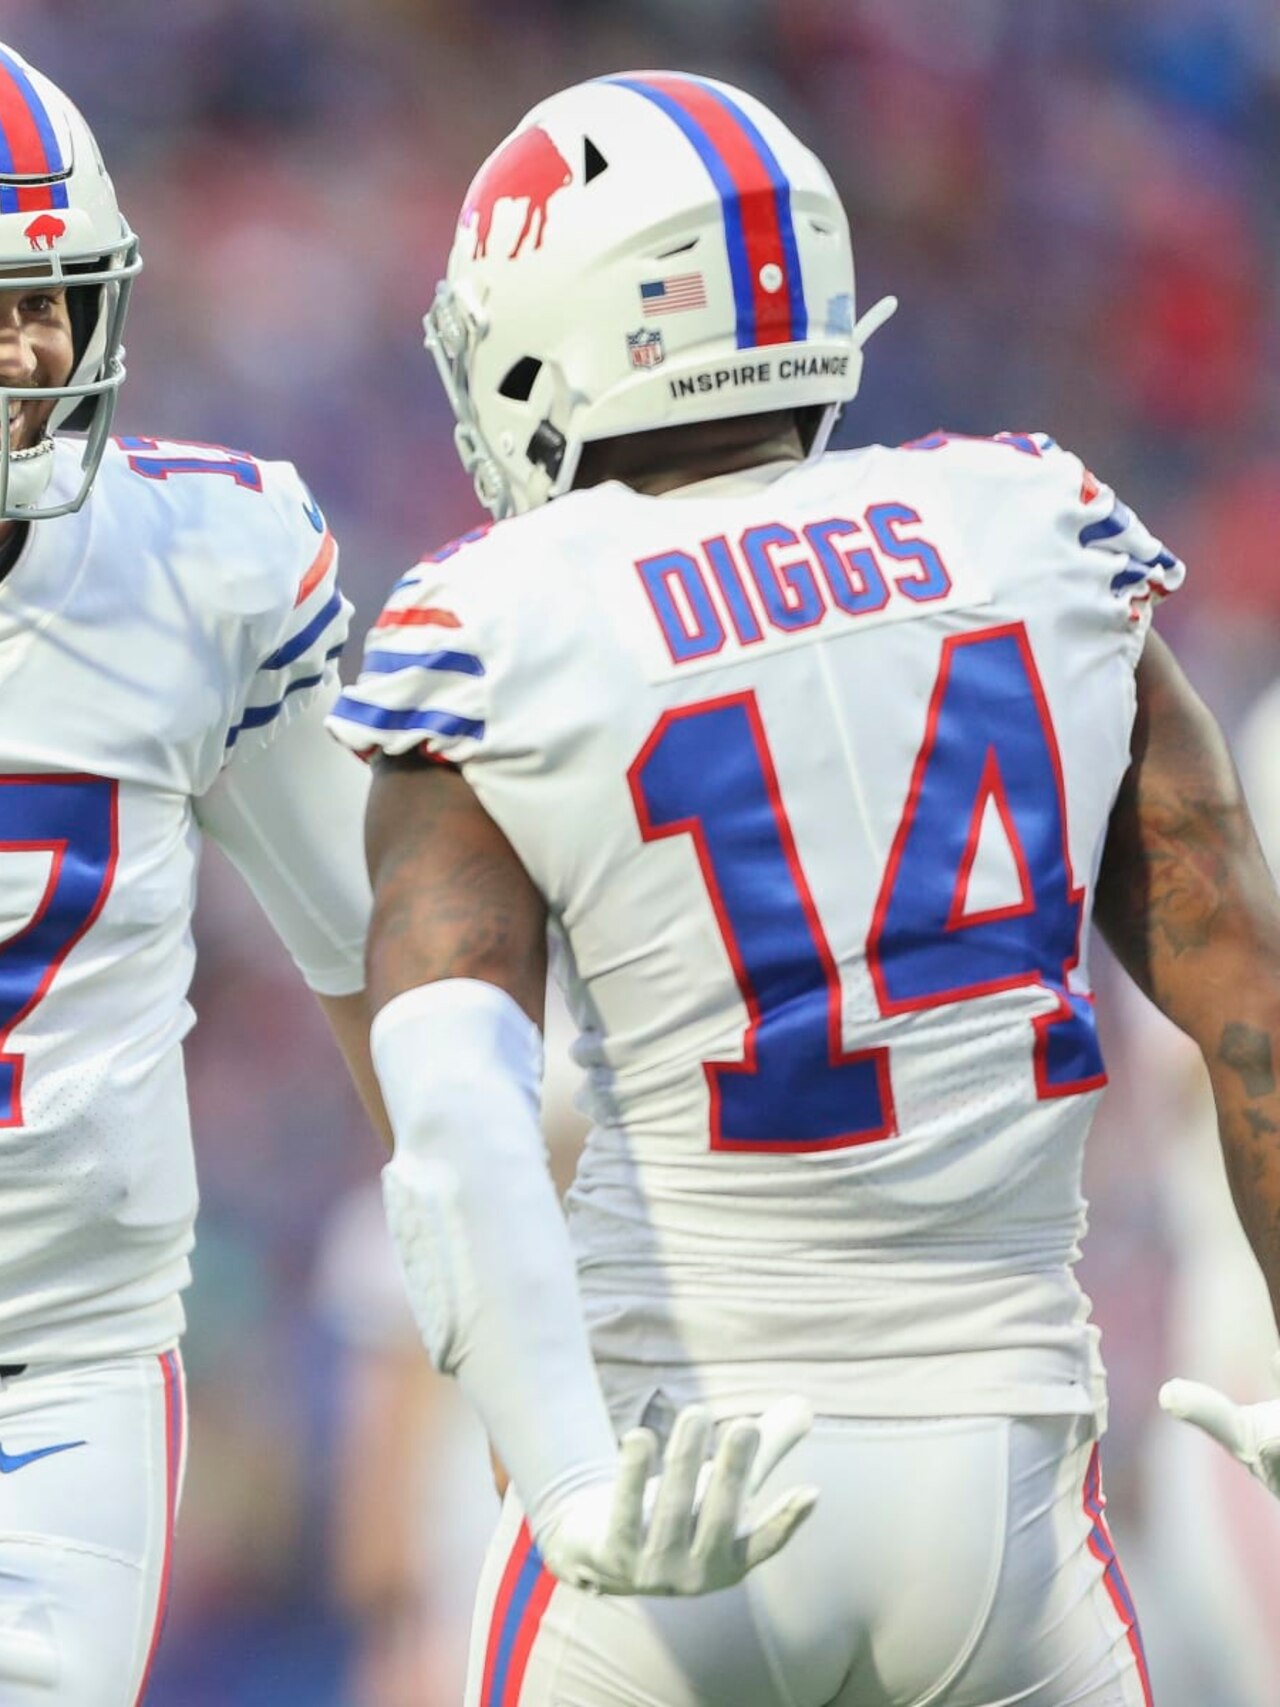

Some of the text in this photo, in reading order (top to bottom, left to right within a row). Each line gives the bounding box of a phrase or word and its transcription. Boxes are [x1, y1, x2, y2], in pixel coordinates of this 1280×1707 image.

[669, 355, 848, 399] INSPIRE CHANGE
[634, 502, 952, 664] DIGGS
[626, 621, 1109, 1154] 14
